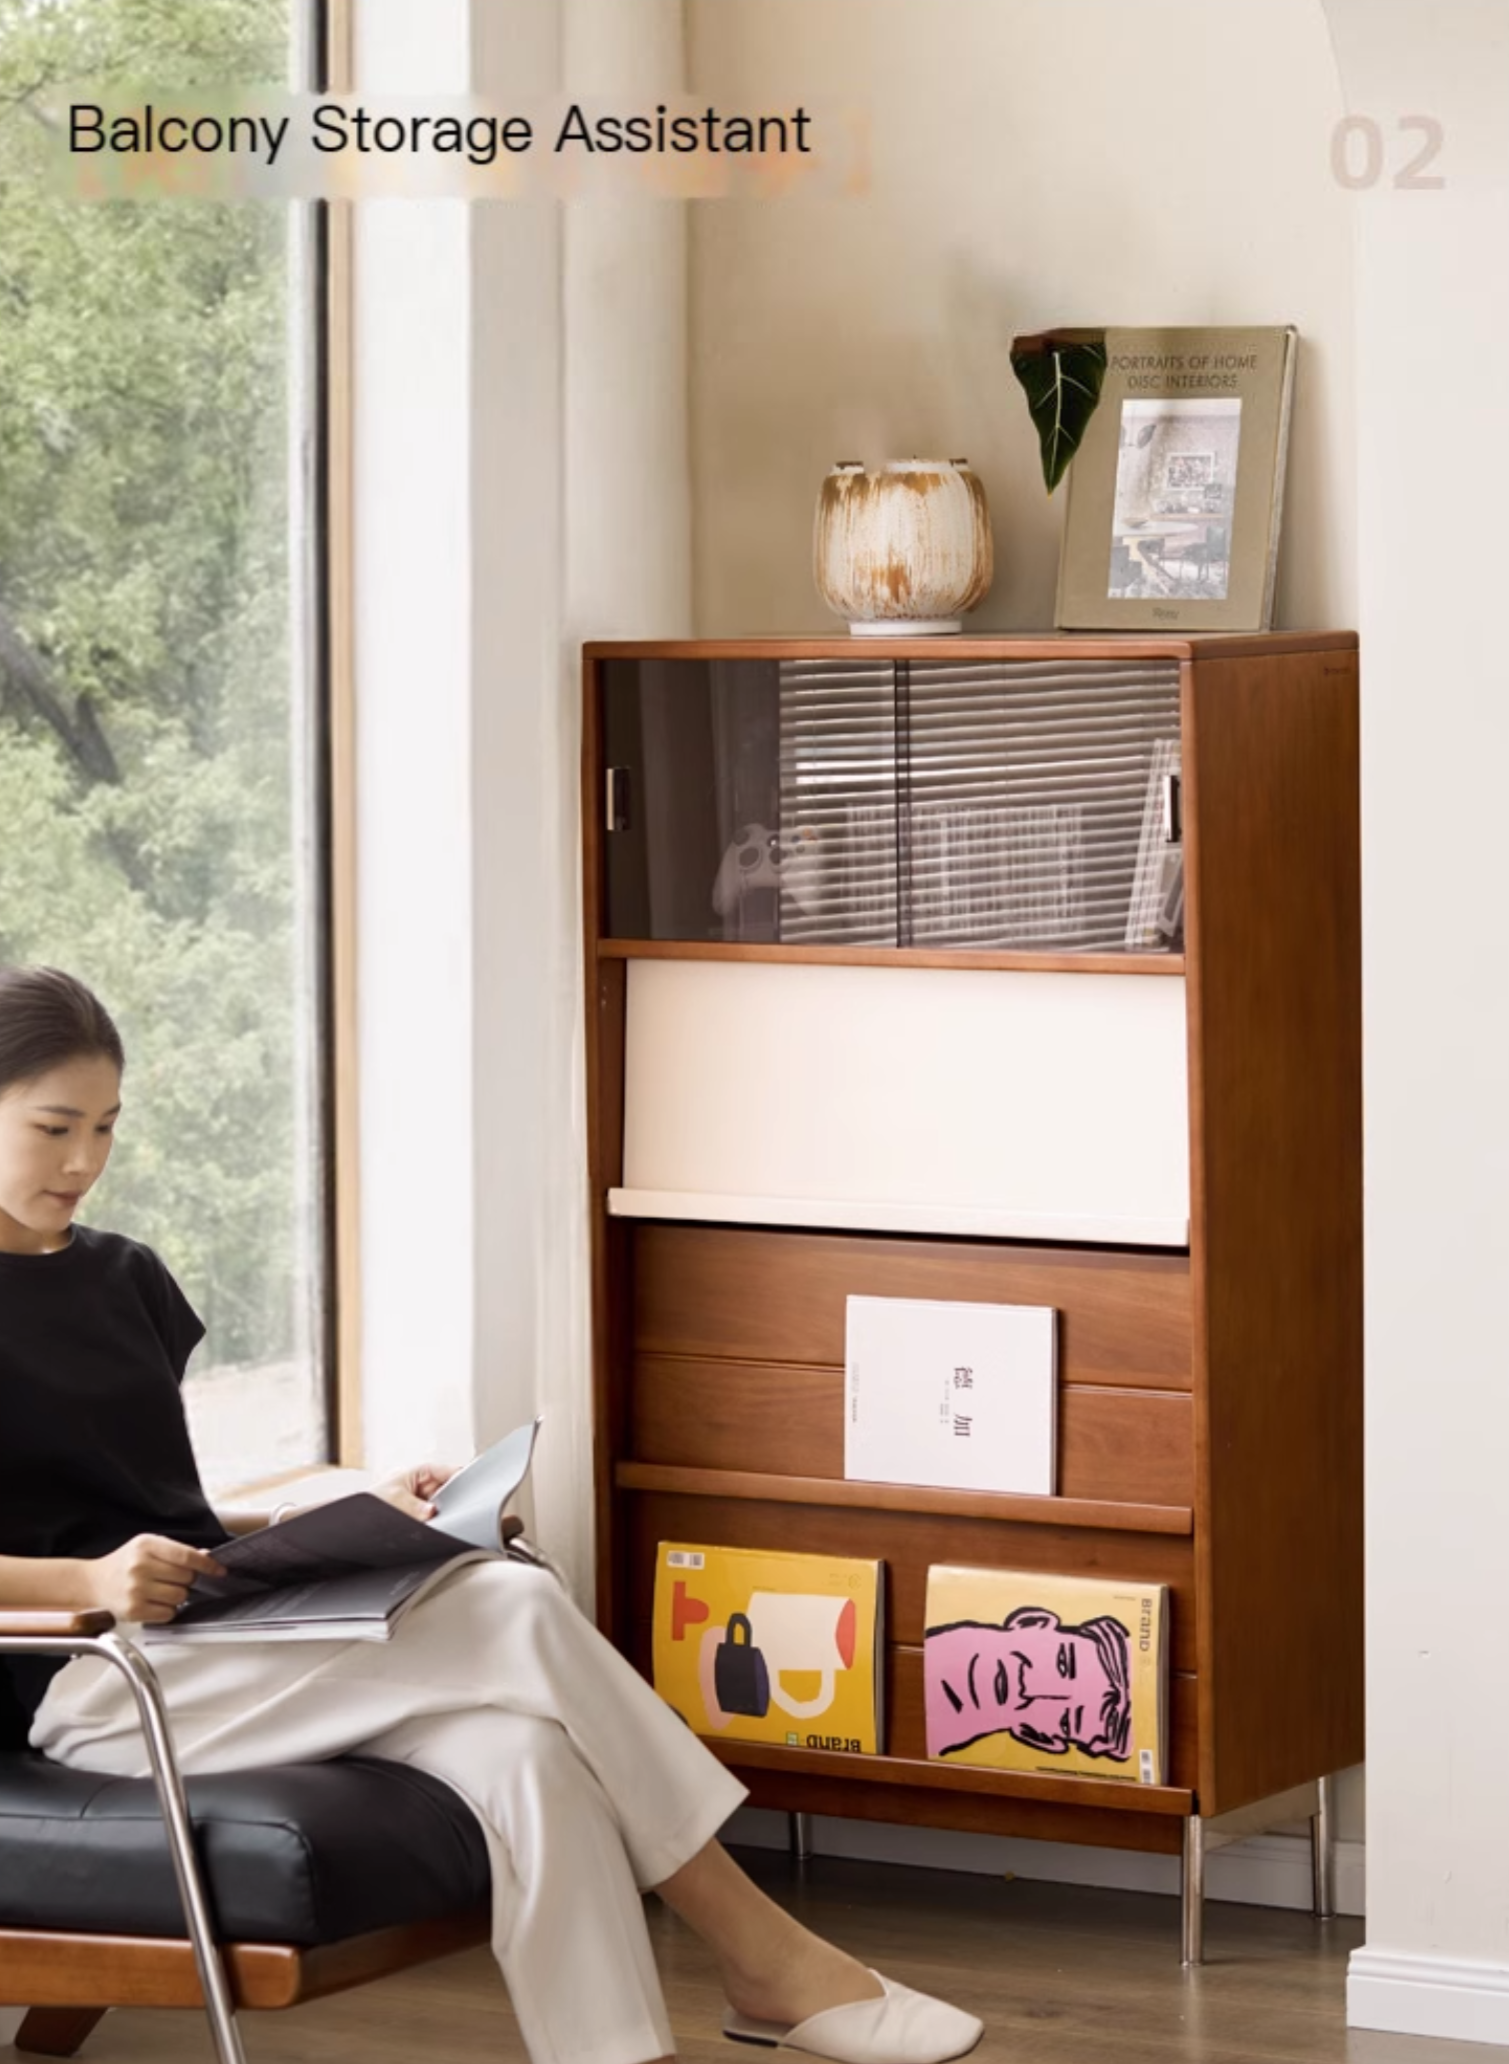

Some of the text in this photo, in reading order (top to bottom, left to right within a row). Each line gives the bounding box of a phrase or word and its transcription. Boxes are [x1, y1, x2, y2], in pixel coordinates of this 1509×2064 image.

[1111, 354, 1258, 371] PORTRAITS OF HOME
[1128, 374, 1237, 389] DISC INTERIORS
